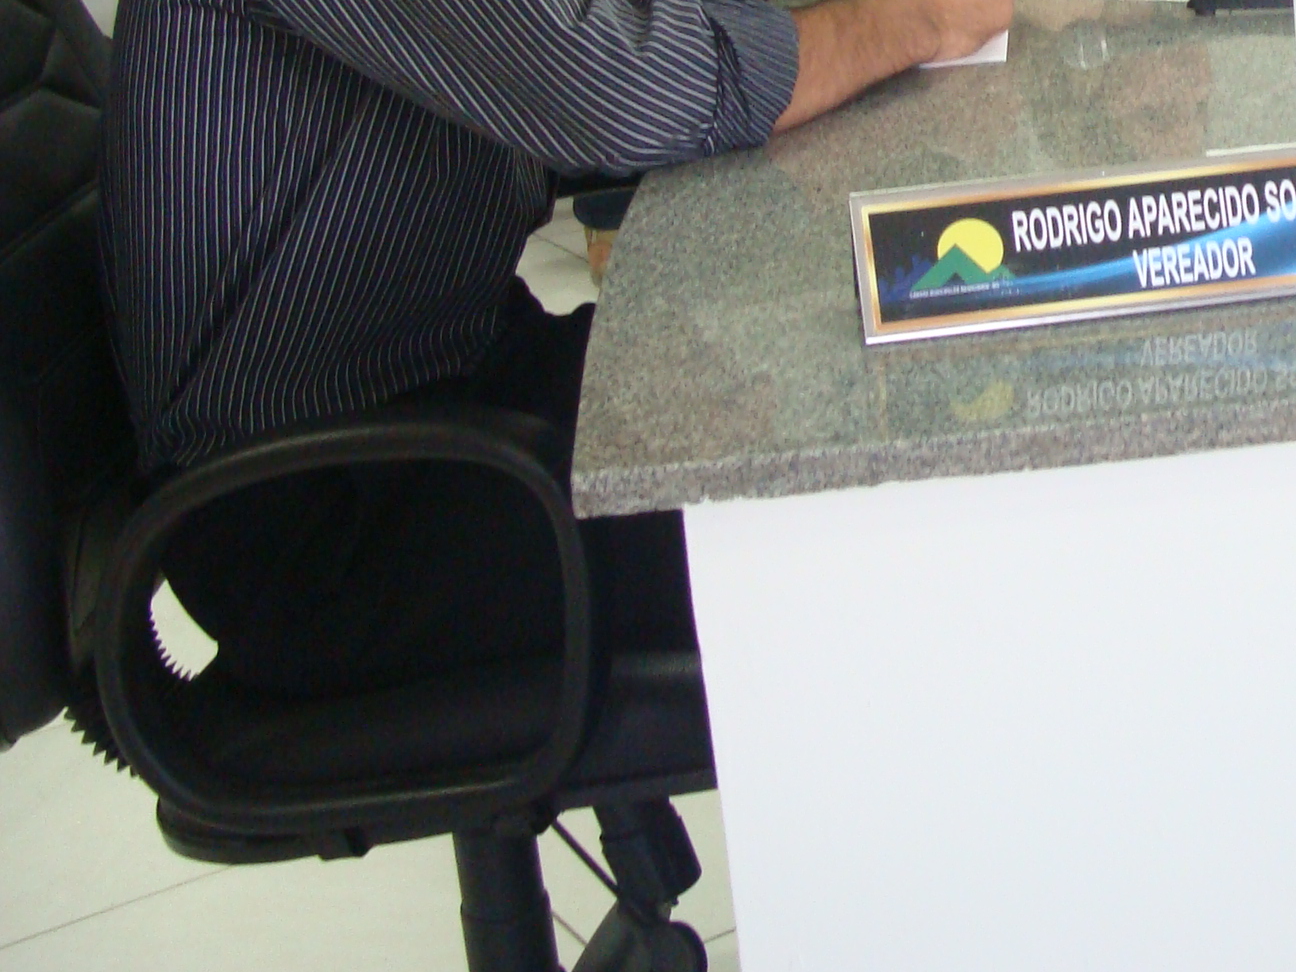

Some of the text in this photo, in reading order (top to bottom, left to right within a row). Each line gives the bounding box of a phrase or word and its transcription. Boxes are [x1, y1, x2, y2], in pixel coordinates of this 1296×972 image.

[1011, 199, 1122, 253] RODRIGO
[1128, 182, 1261, 239] APARECIDO
[1132, 237, 1256, 289] VEREADOR
